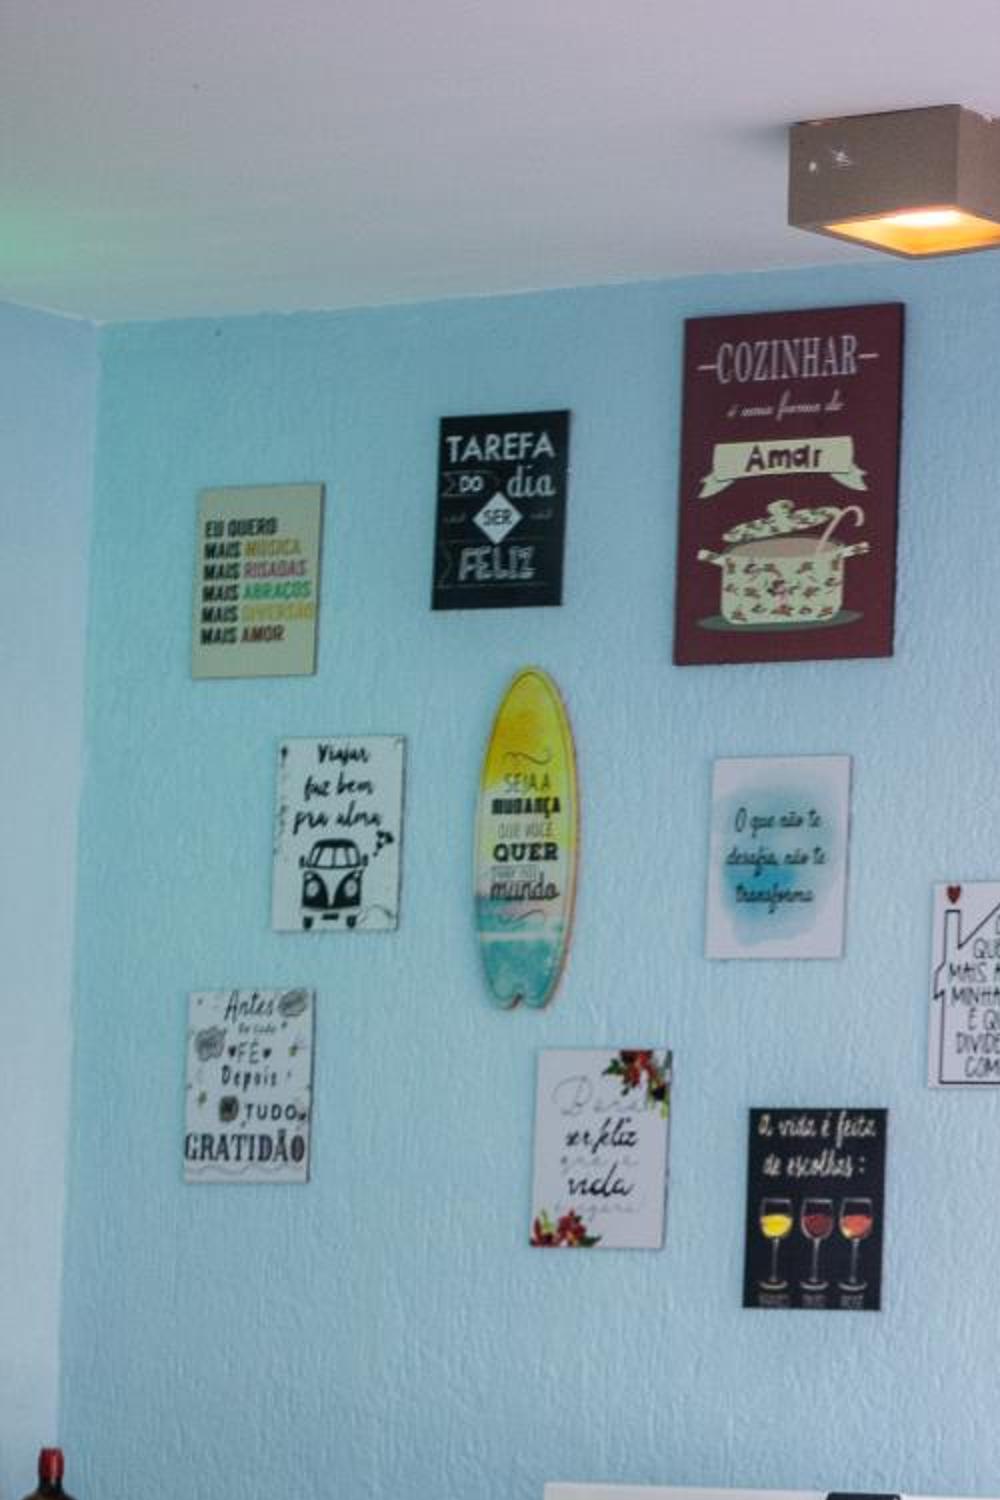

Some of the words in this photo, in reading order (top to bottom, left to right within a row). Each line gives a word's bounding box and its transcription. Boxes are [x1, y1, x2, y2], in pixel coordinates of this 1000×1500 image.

[716, 335, 858, 384] COZINHAR
[446, 432, 556, 463] TAREFA
[744, 444, 823, 473] Amar
[507, 465, 556, 498] dia
[205, 519, 224, 537] EU
[227, 516, 278, 537] QUERO
[482, 508, 513, 526] SER
[204, 541, 241, 559] MAIS
[203, 563, 240, 580] MAIS
[458, 545, 537, 581] FELIZ
[201, 584, 239, 602] MAIS
[201, 605, 238, 623] MAIS
[200, 626, 238, 645] MAIS
[240, 624, 286, 643] AMOR
[734, 807, 748, 832] O
[493, 842, 559, 862] QUER
[184, 1128, 306, 1163] GRATIDÃO
[568, 1162, 636, 1198] vida
